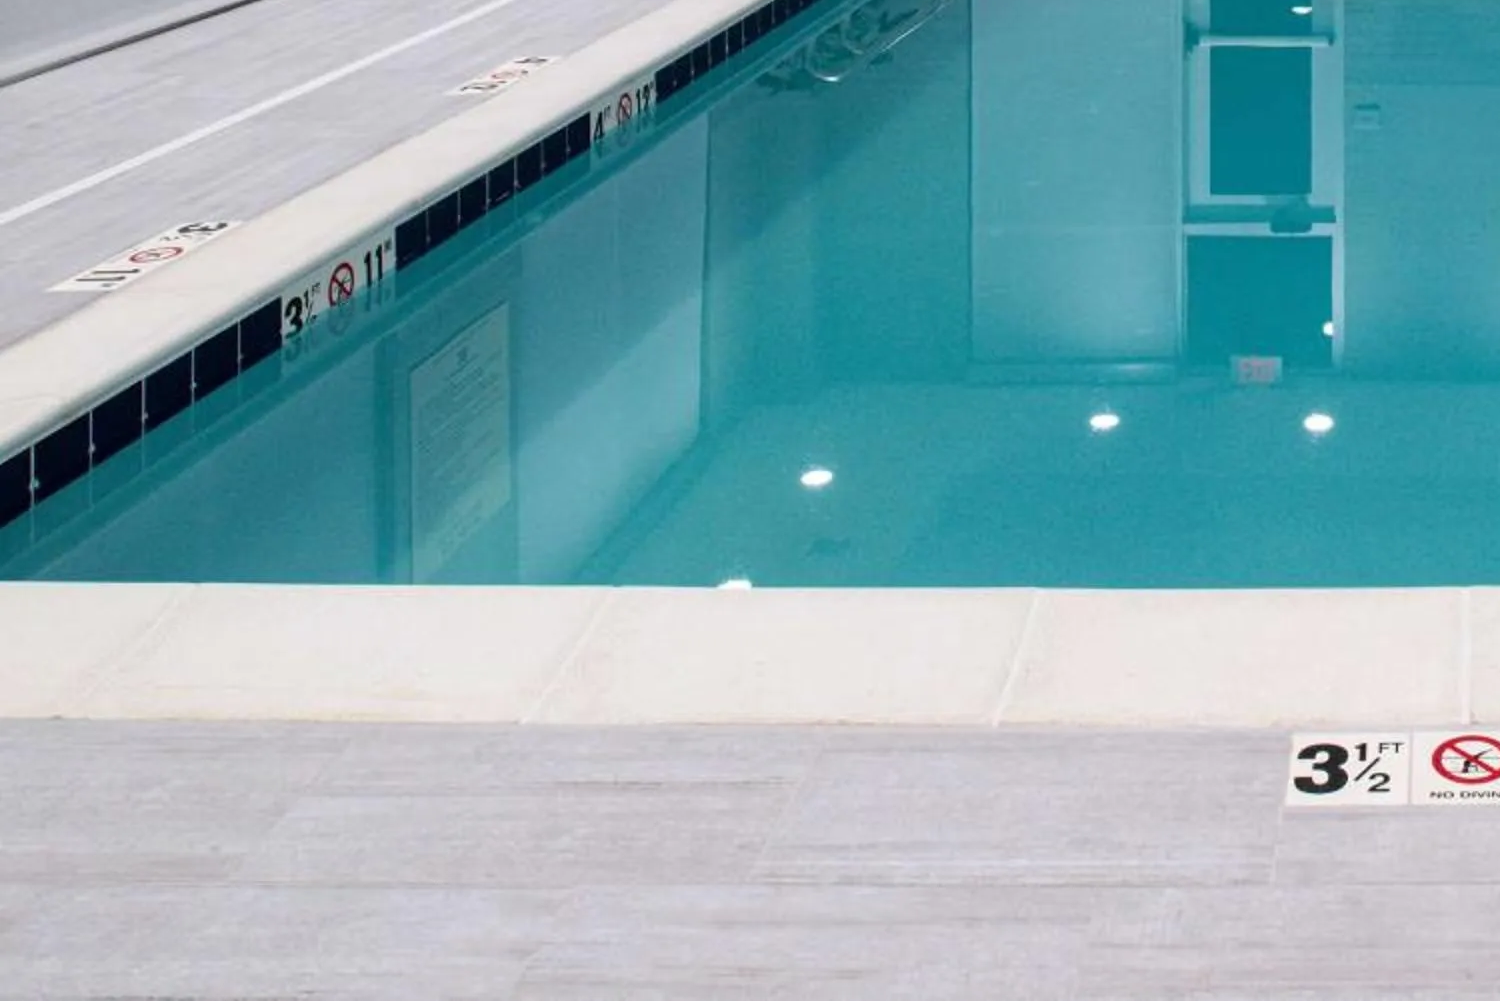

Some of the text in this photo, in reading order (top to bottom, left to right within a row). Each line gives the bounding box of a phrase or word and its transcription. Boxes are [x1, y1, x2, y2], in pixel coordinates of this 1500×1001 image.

[285, 296, 303, 339] 3
[1293, 742, 1349, 795] 3
[1378, 742, 1404, 754] FT
[1430, 790, 1455, 799] NO
